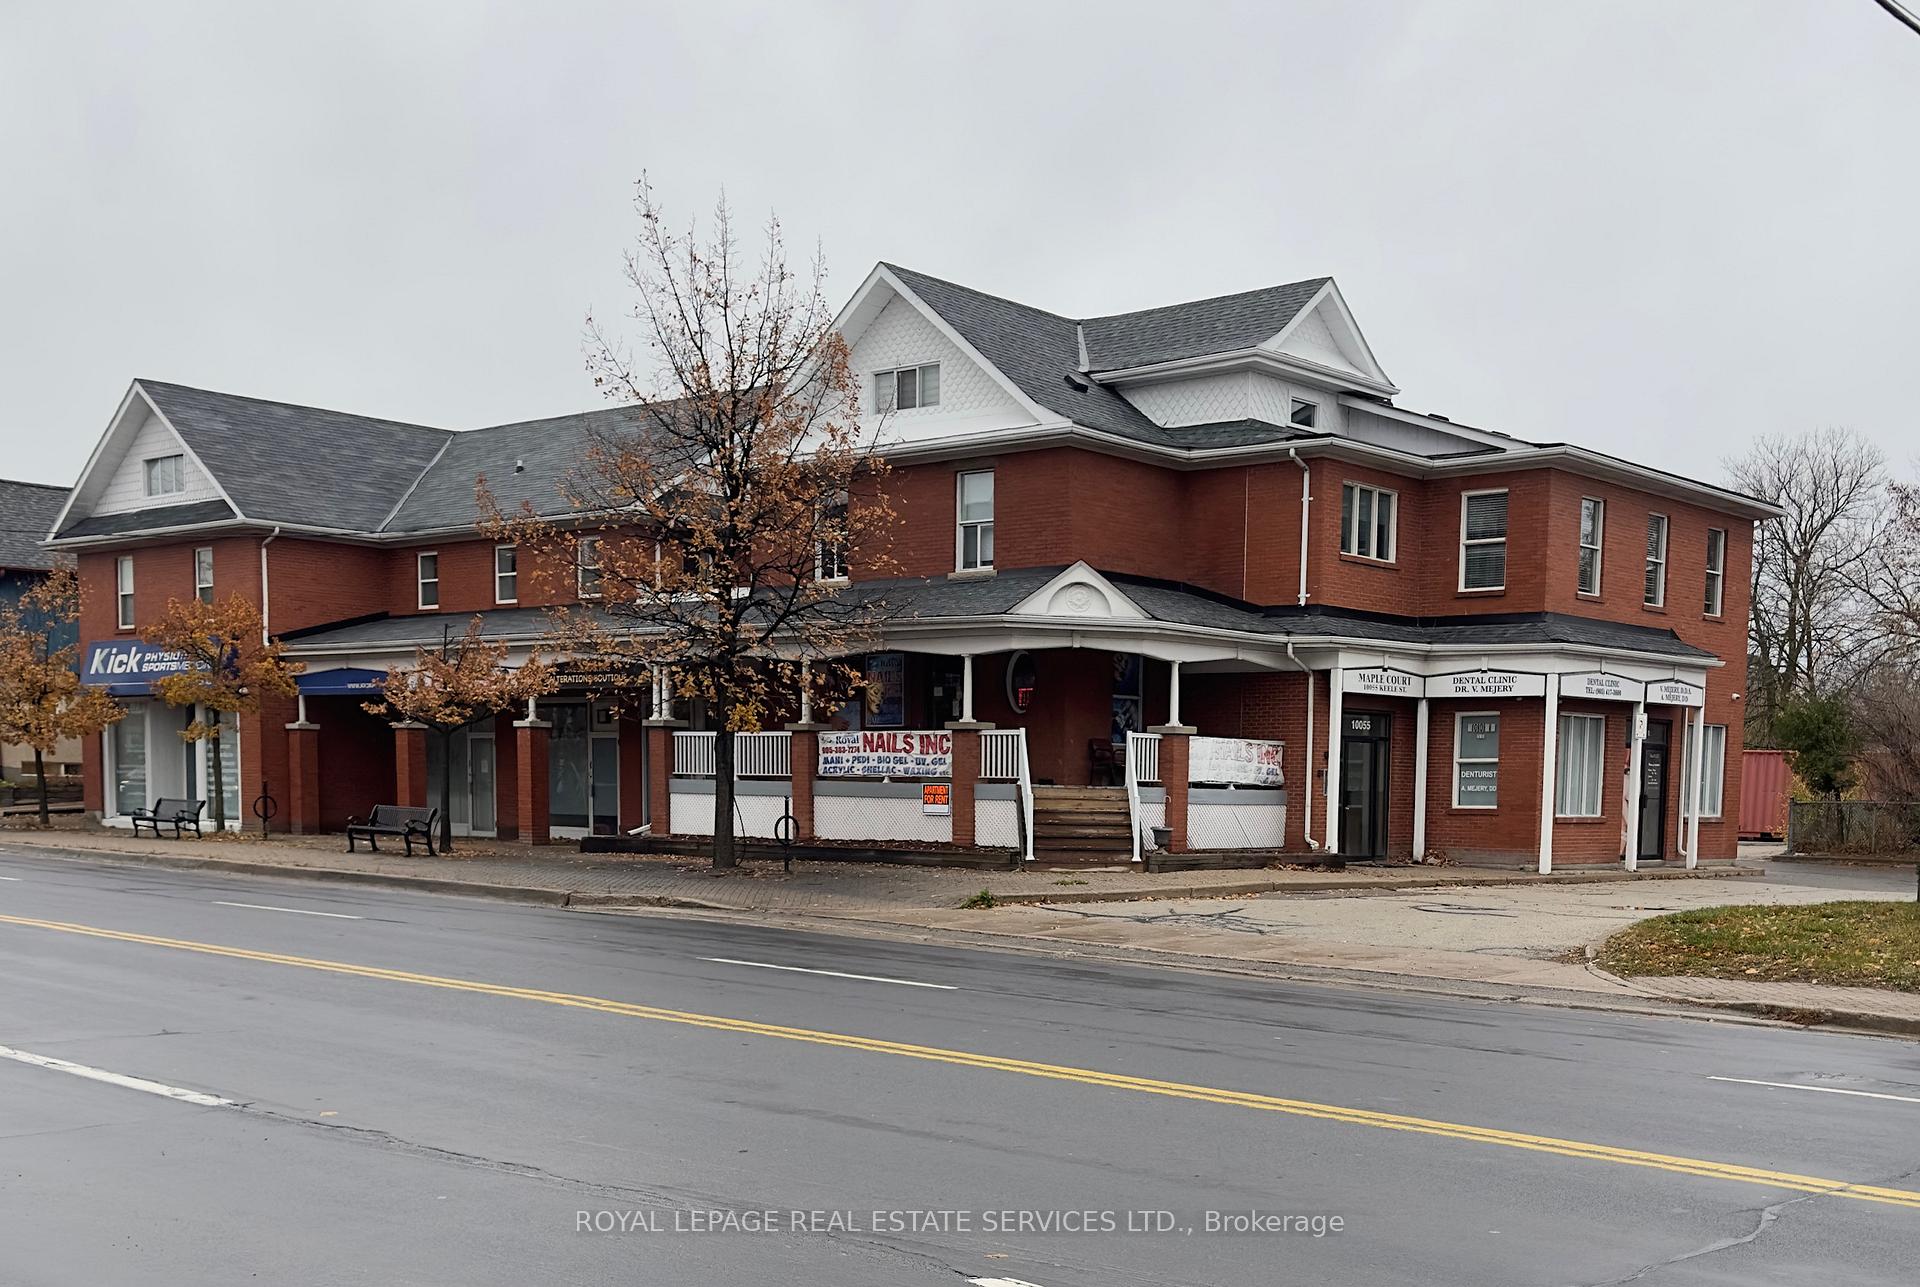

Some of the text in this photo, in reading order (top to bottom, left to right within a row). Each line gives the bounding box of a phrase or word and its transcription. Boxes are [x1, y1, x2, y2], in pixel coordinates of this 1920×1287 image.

[90, 646, 143, 674] Kick
[1358, 673, 1412, 686] MAPLE COURT
[1452, 675, 1518, 685] DENTAL CLINIC
[1587, 678, 1620, 688] DENTAL CLINIC
[1454, 685, 1470, 694] DR.
[1481, 684, 1514, 695] MEJERY
[1351, 720, 1371, 730] 10055
[862, 731, 915, 754] NAILS
[822, 755, 843, 765] MANI
[852, 755, 869, 765] PEDI
[876, 755, 891, 764] BIO
[893, 756, 909, 765] GEL
[931, 757, 947, 766] GEL
[822, 765, 855, 775] ACRYLIC
[861, 765, 896, 775] SHELLAC
[903, 766, 937, 776] WAXING
[1461, 770, 1497, 778] DENTURIST
[924, 785, 948, 794] APARTMENT
[924, 795, 948, 804] FOR RENT
